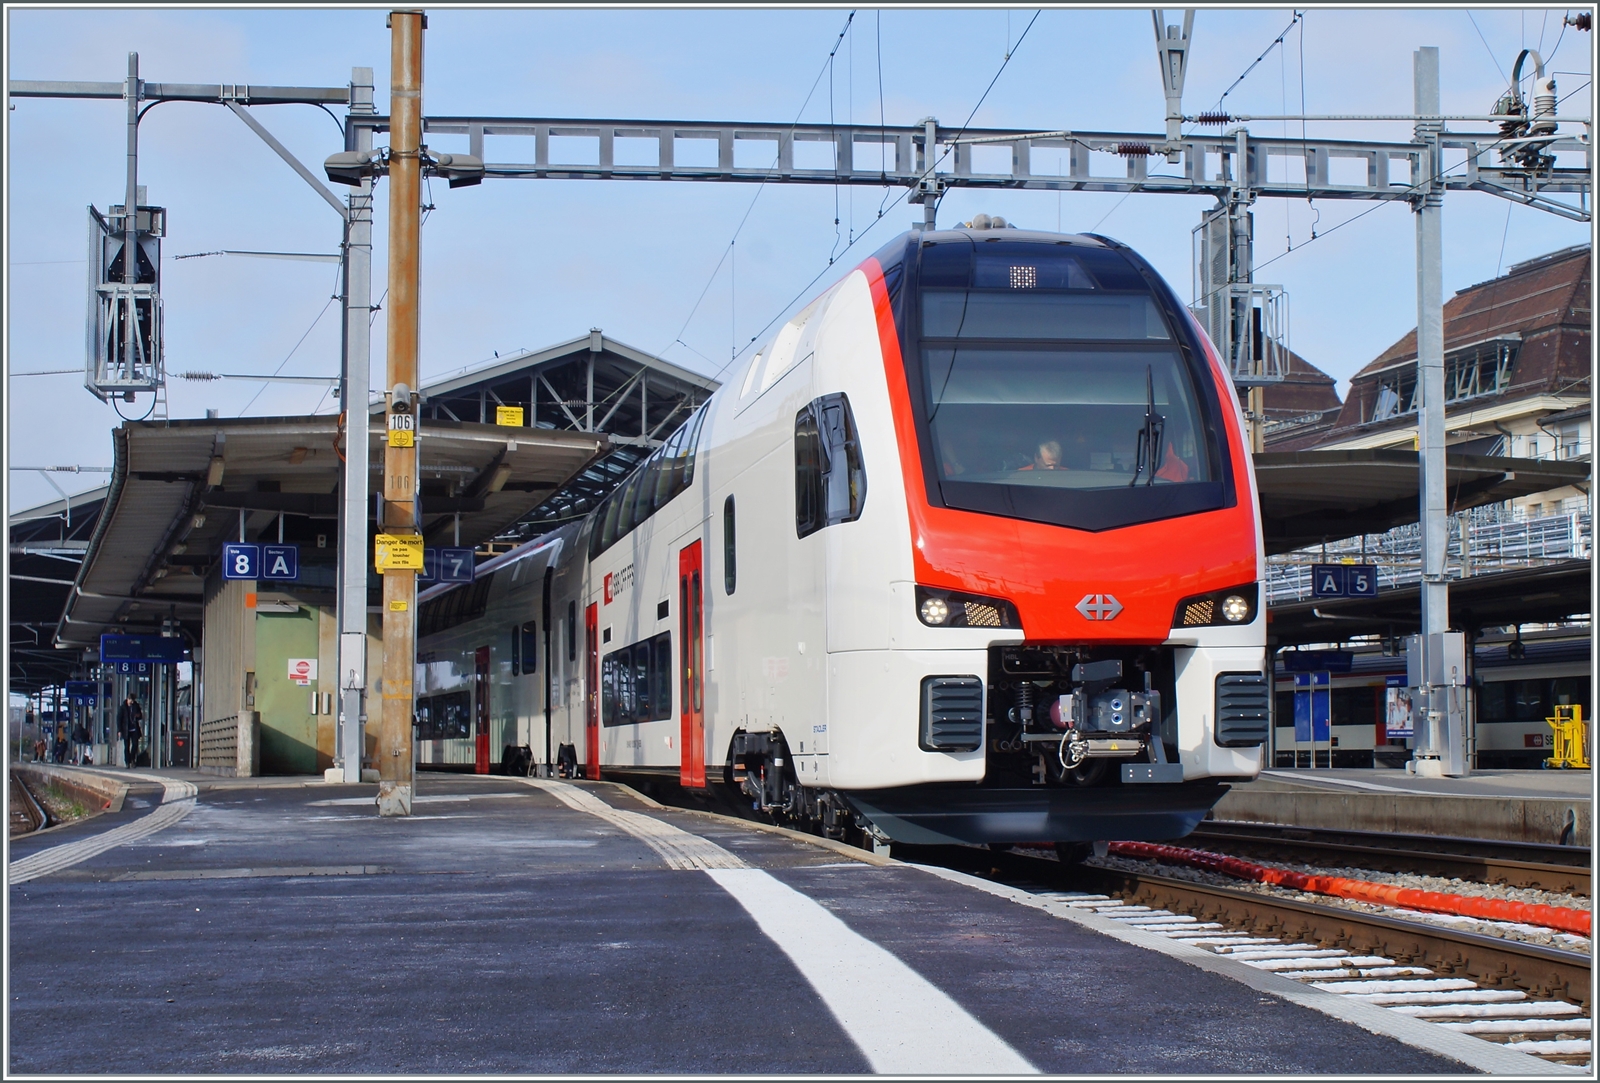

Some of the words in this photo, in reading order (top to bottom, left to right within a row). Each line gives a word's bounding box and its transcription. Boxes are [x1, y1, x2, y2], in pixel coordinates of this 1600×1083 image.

[392, 415, 410, 430] 106
[390, 476, 409, 490] 106
[235, 554, 250, 574] 8
[271, 556, 289, 574] A
[450, 559, 463, 577] 7
[1322, 575, 1338, 592] A
[1356, 575, 1368, 592] 5
[122, 662, 129, 672] 8
[138, 662, 146, 672] B
[813, 724, 826, 733] STADLER
